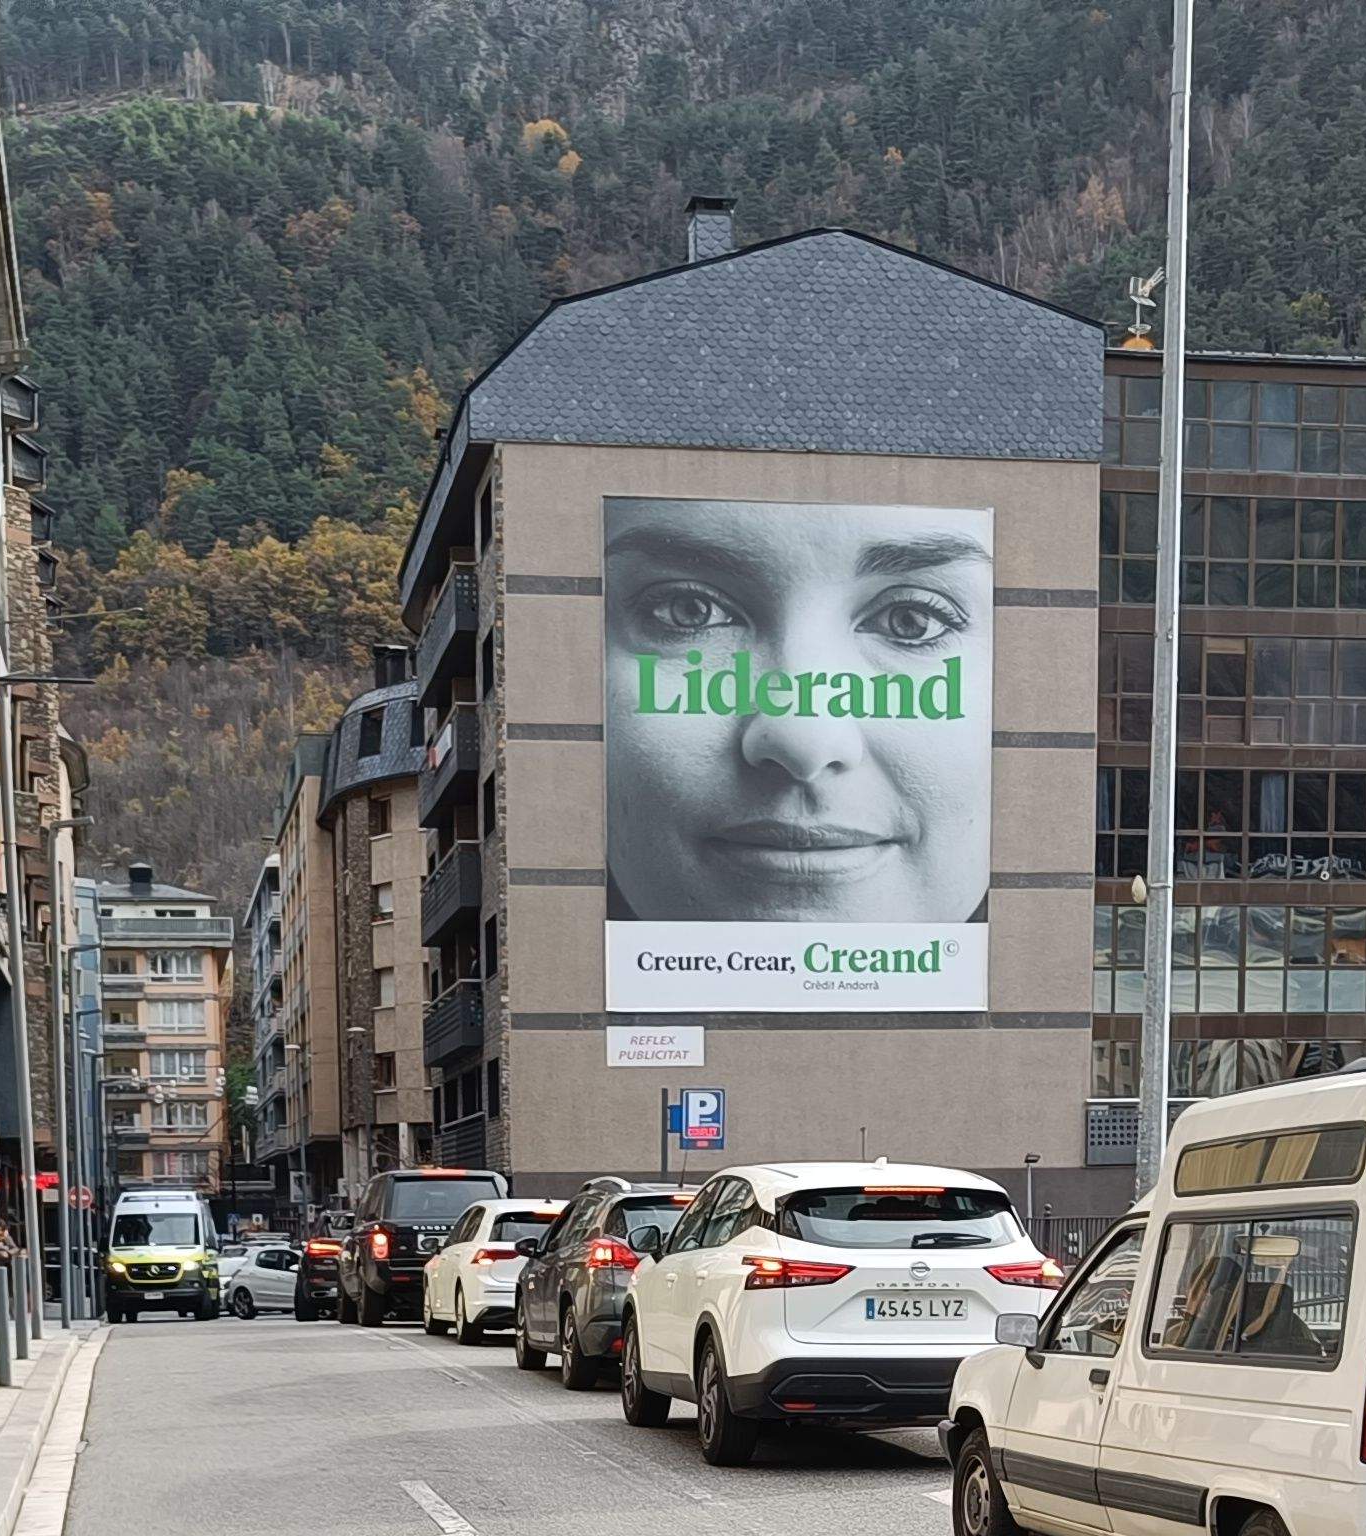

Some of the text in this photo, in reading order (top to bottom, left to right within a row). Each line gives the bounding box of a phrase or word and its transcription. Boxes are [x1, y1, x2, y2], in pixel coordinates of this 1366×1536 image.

[635, 650, 965, 720] Liderand
[637, 940, 941, 974] Creure, Crear, Creand
[803, 980, 879, 991] Crèdit Andorrà
[630, 1035, 676, 1045] REFLEX
[619, 1051, 690, 1060] PUBLICITAT
[688, 1092, 718, 1126] P
[878, 1300, 963, 1317] 4545 LYZ
